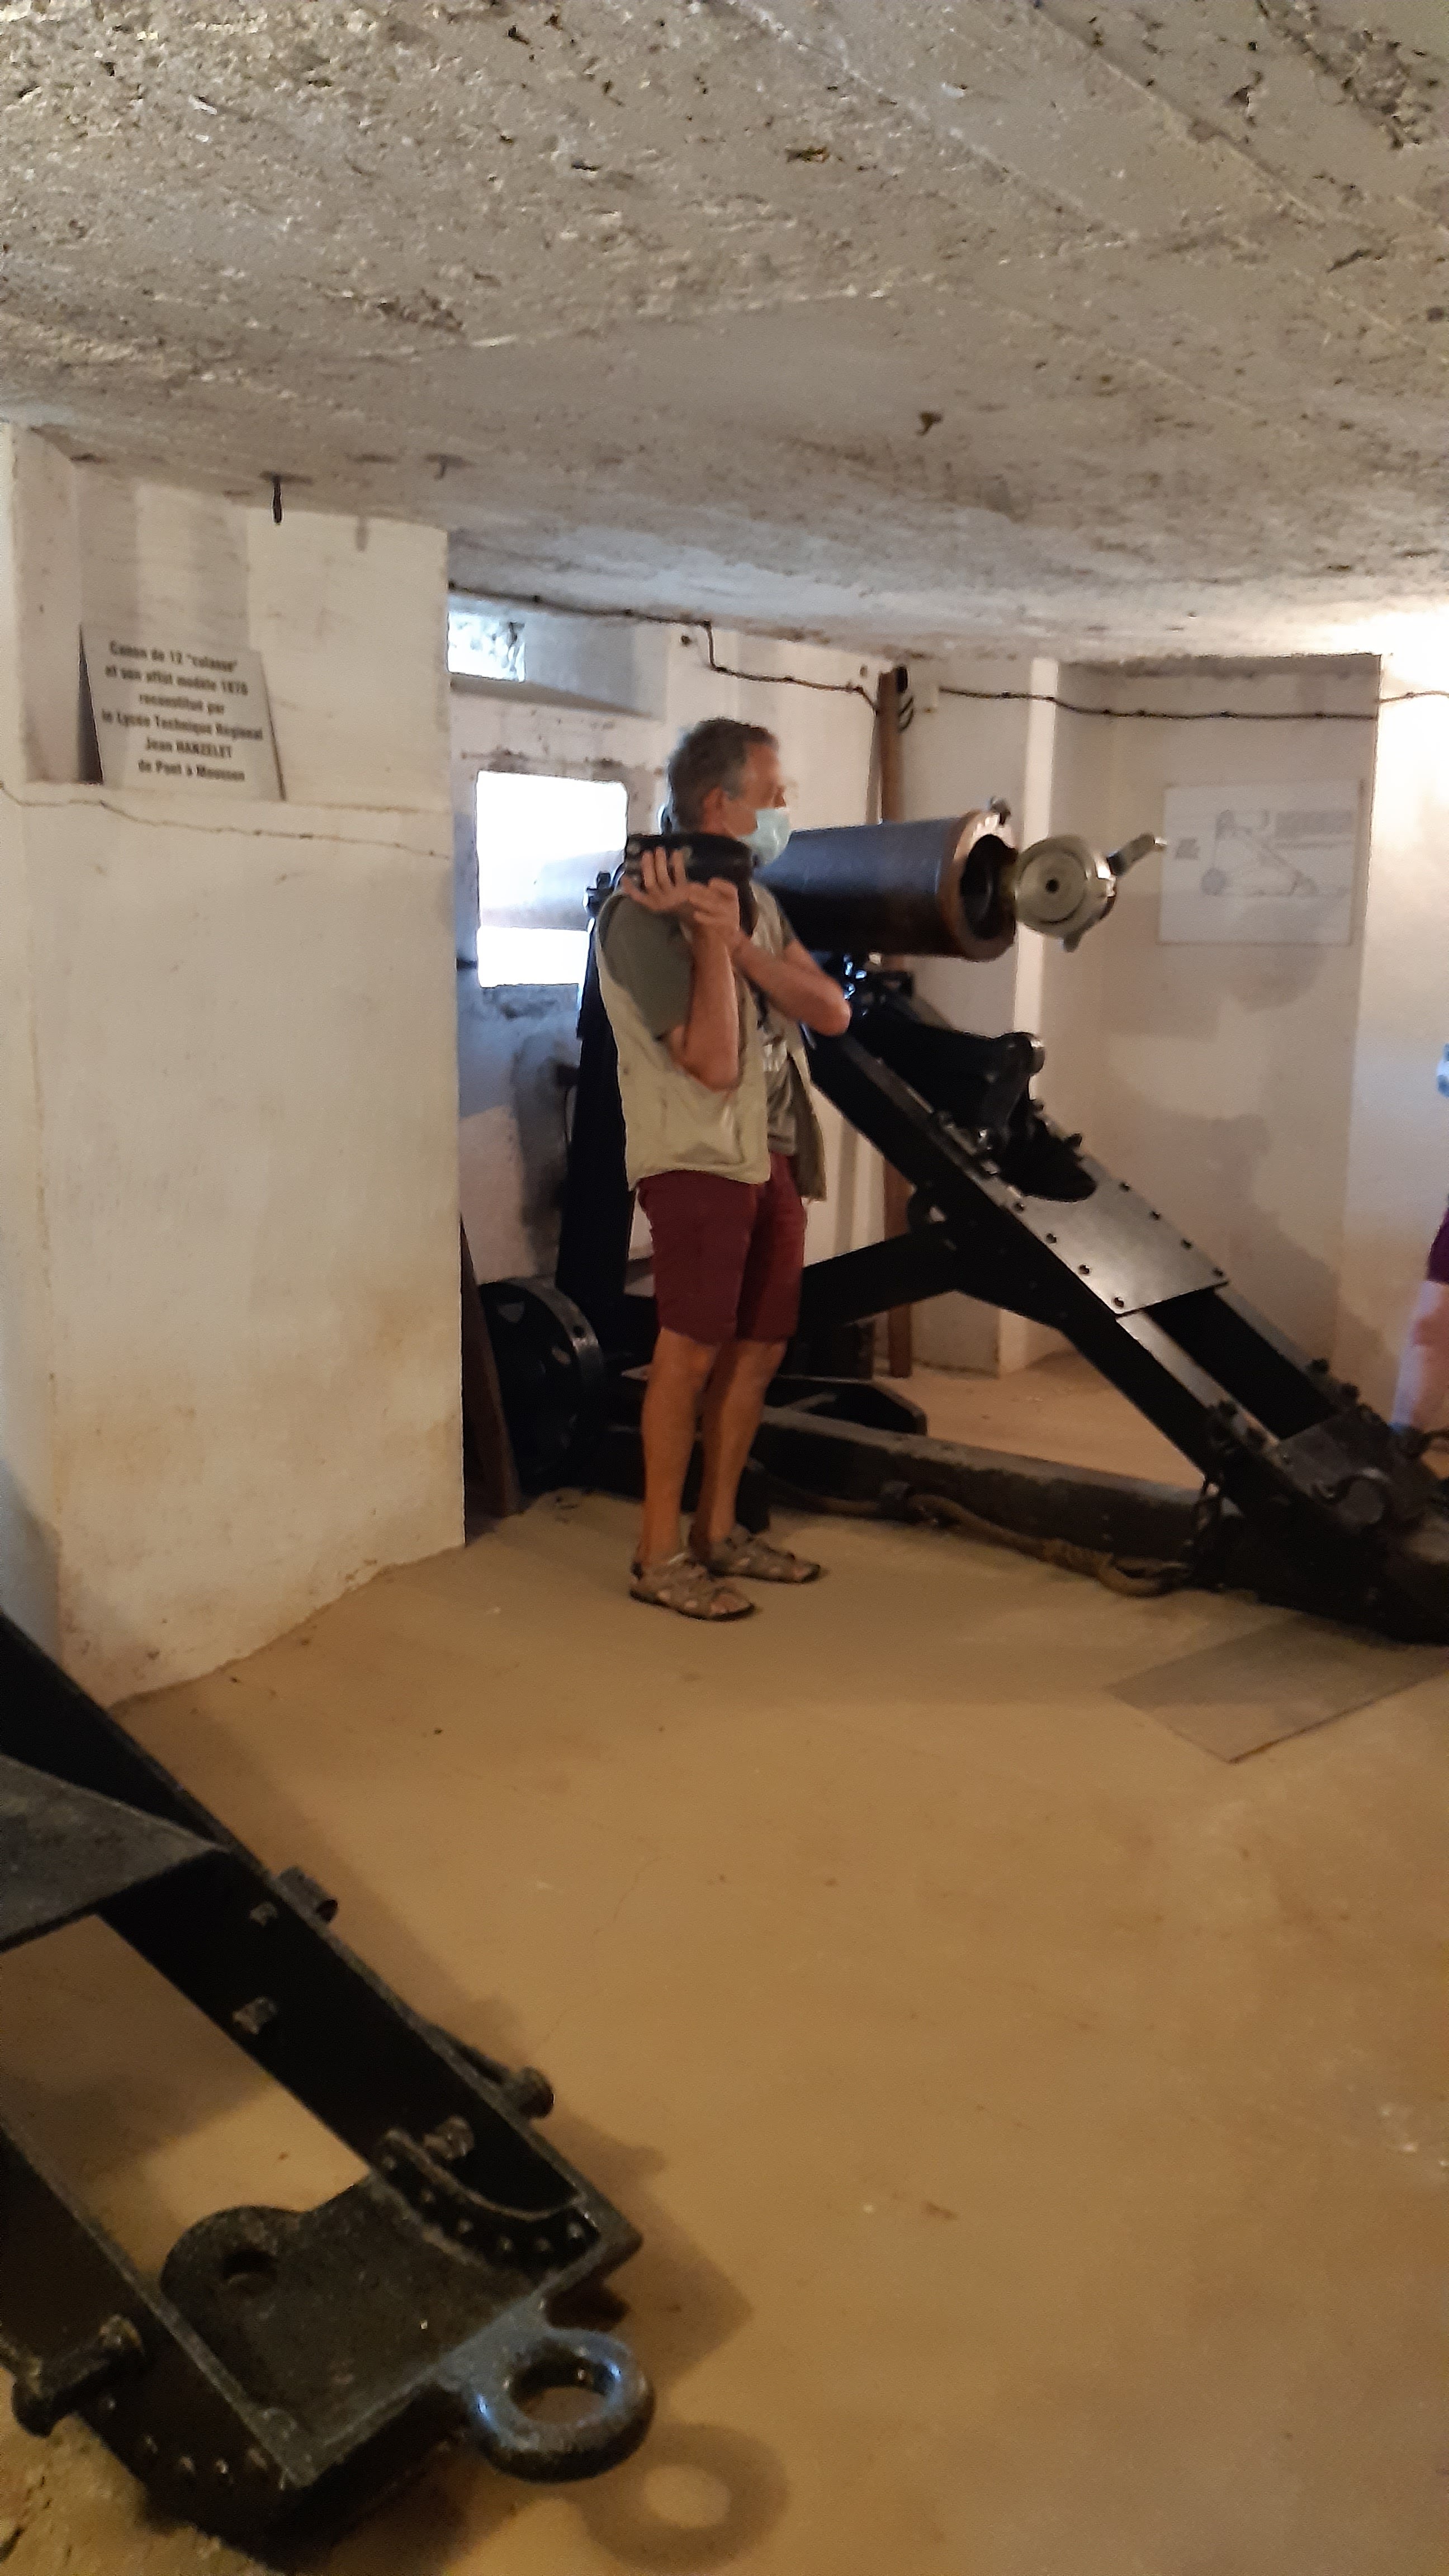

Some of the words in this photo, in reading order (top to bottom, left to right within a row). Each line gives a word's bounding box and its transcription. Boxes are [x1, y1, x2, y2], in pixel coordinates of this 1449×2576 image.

[151, 648, 164, 662] de
[207, 703, 224, 714] par
[155, 714, 211, 735] Technique
[139, 759, 151, 773] de
[155, 760, 181, 774] Pont
